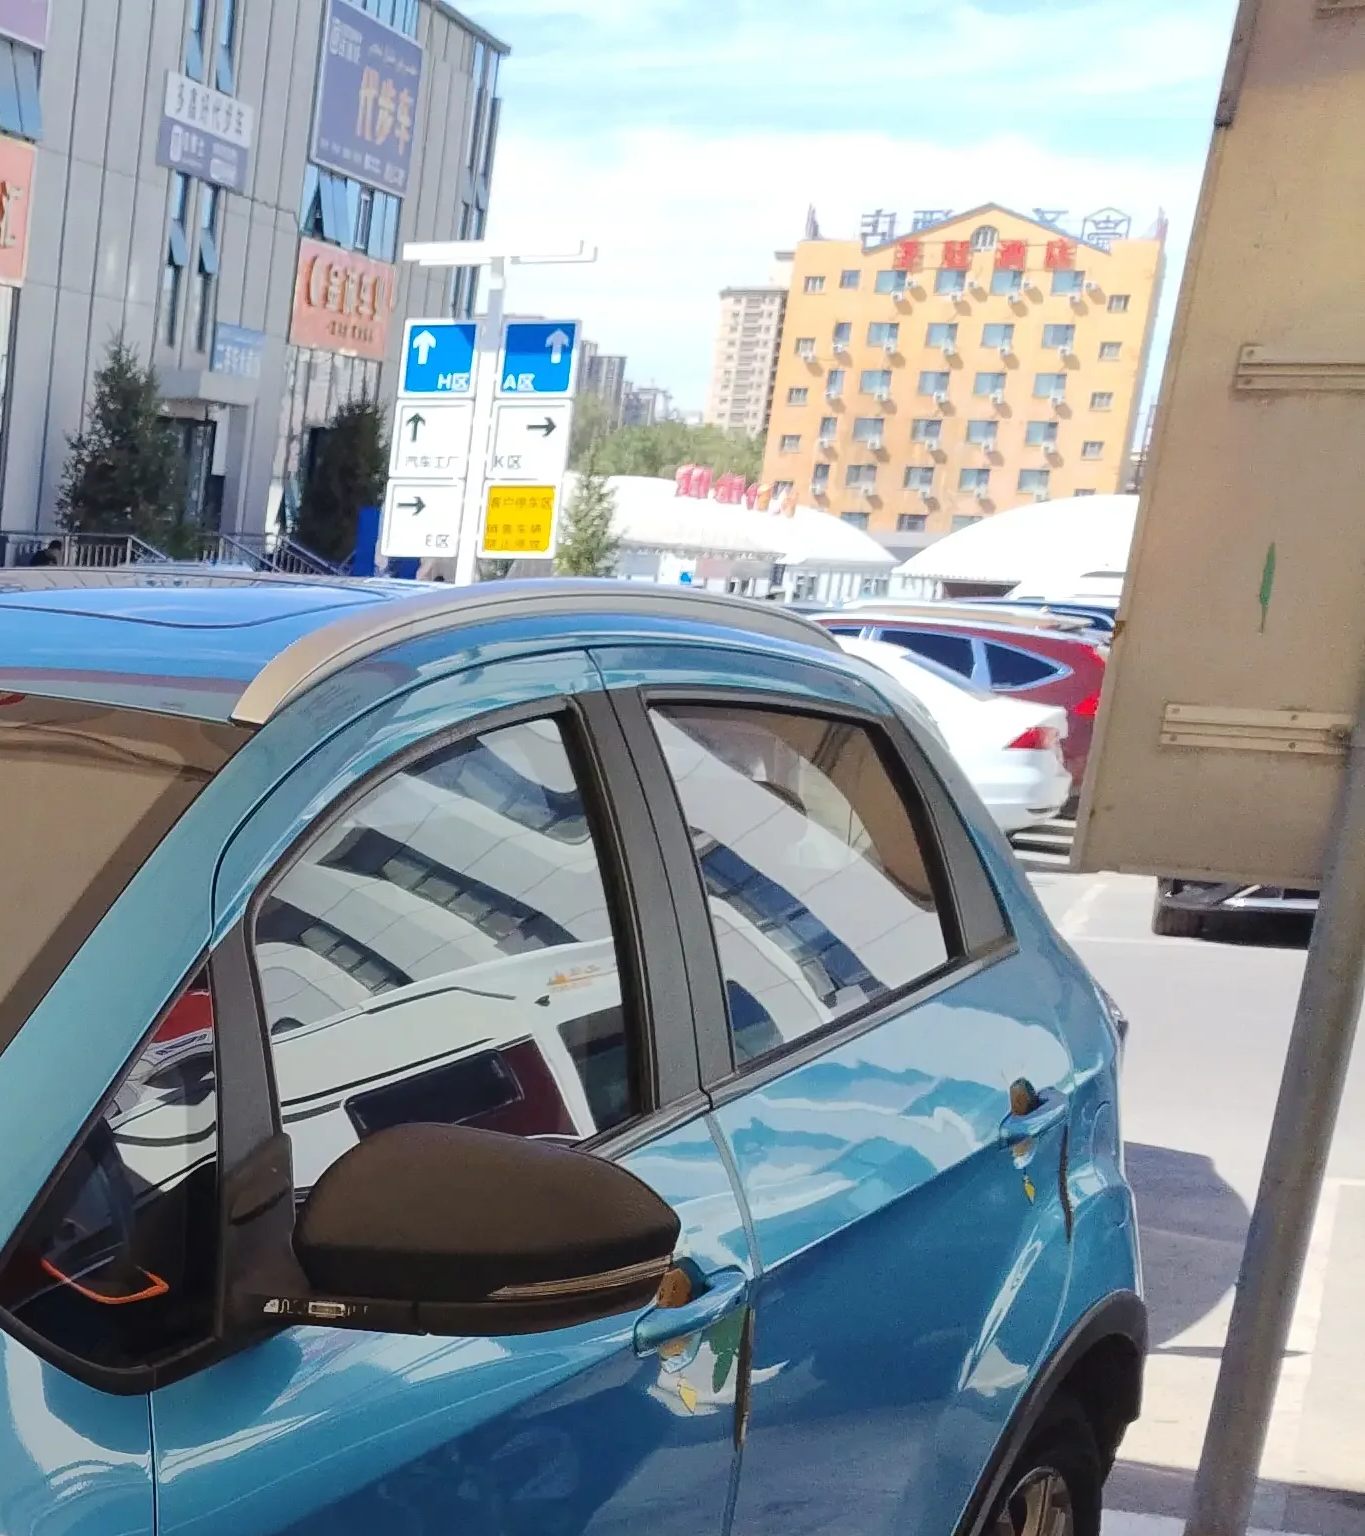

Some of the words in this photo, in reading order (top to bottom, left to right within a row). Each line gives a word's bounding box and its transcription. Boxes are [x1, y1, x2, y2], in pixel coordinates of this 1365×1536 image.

[437, 373, 469, 390] H区
[502, 373, 535, 390] A区
[405, 456, 458, 469] 汽车工厂
[494, 454, 521, 469] K区
[425, 534, 450, 548] E区
